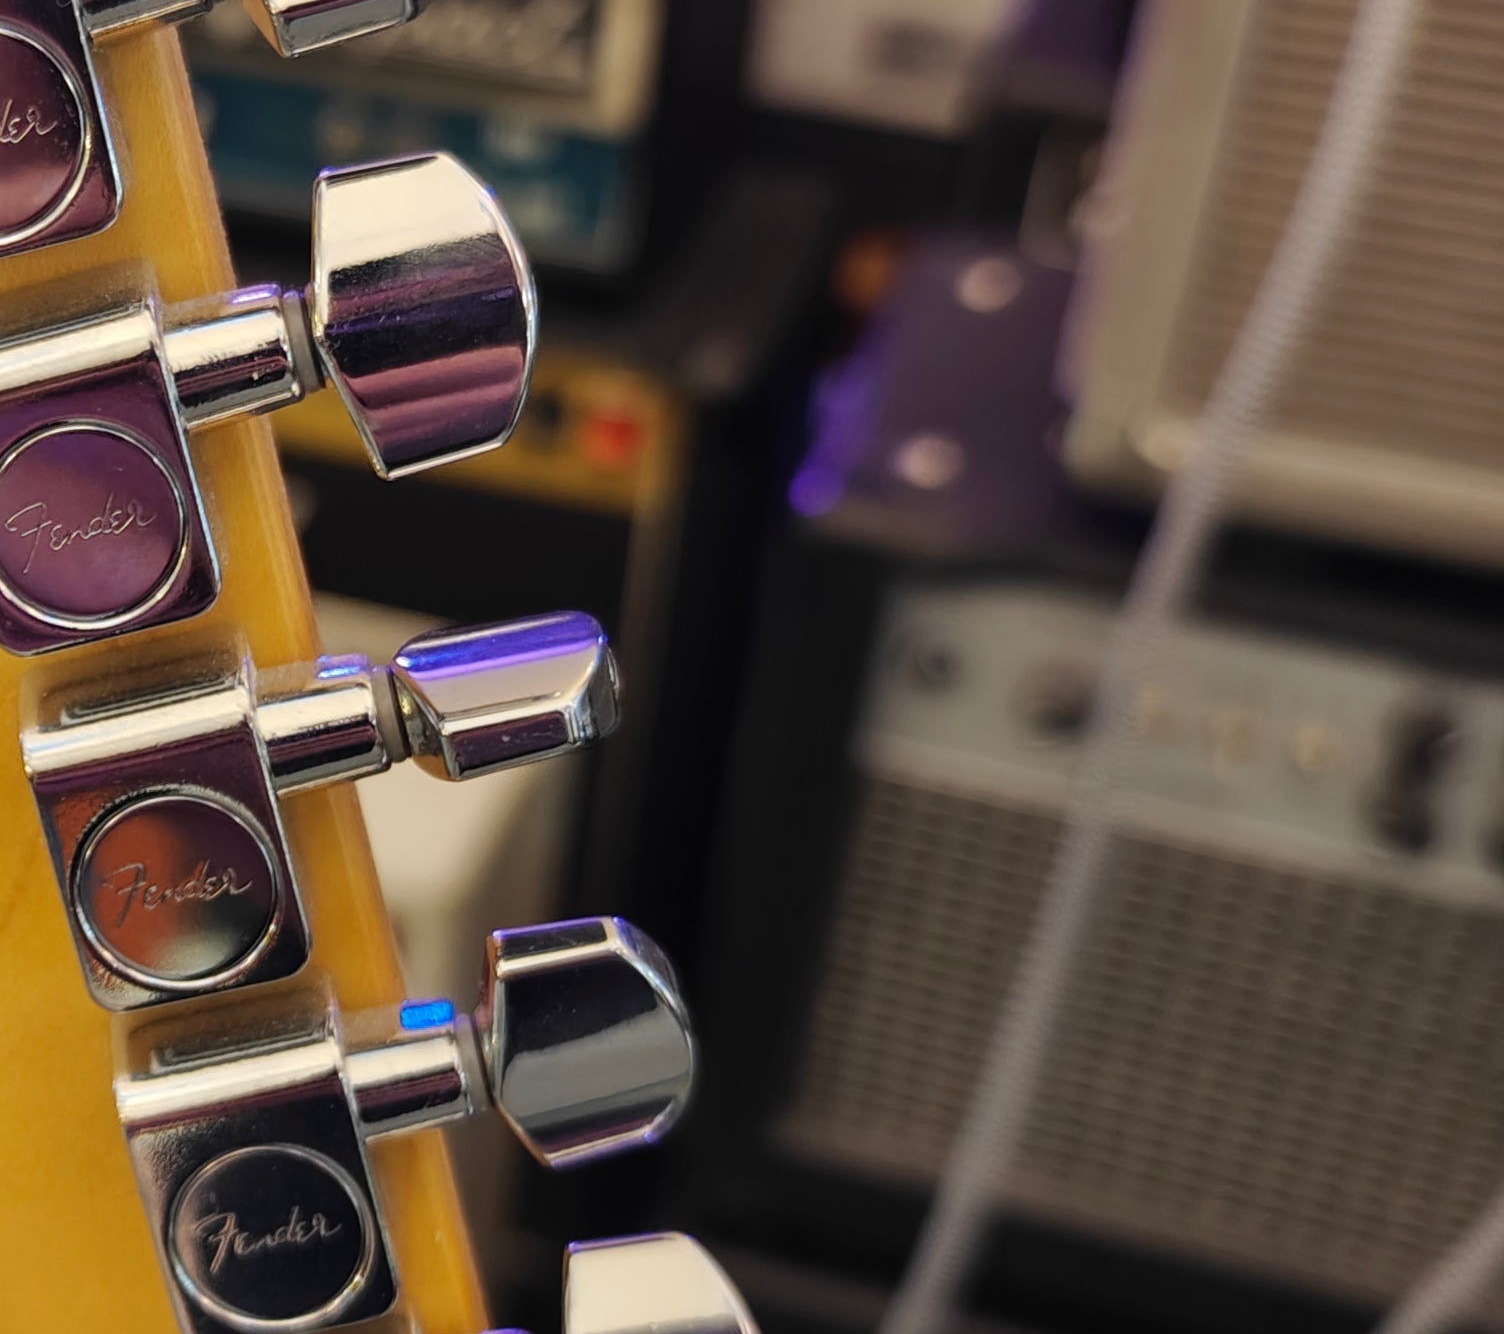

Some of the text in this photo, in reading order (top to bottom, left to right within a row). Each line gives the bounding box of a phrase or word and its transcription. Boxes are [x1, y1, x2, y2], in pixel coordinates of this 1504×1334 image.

[3, 491, 158, 575] Fender
[100, 859, 253, 928] Fender
[193, 1203, 342, 1275] Fender
